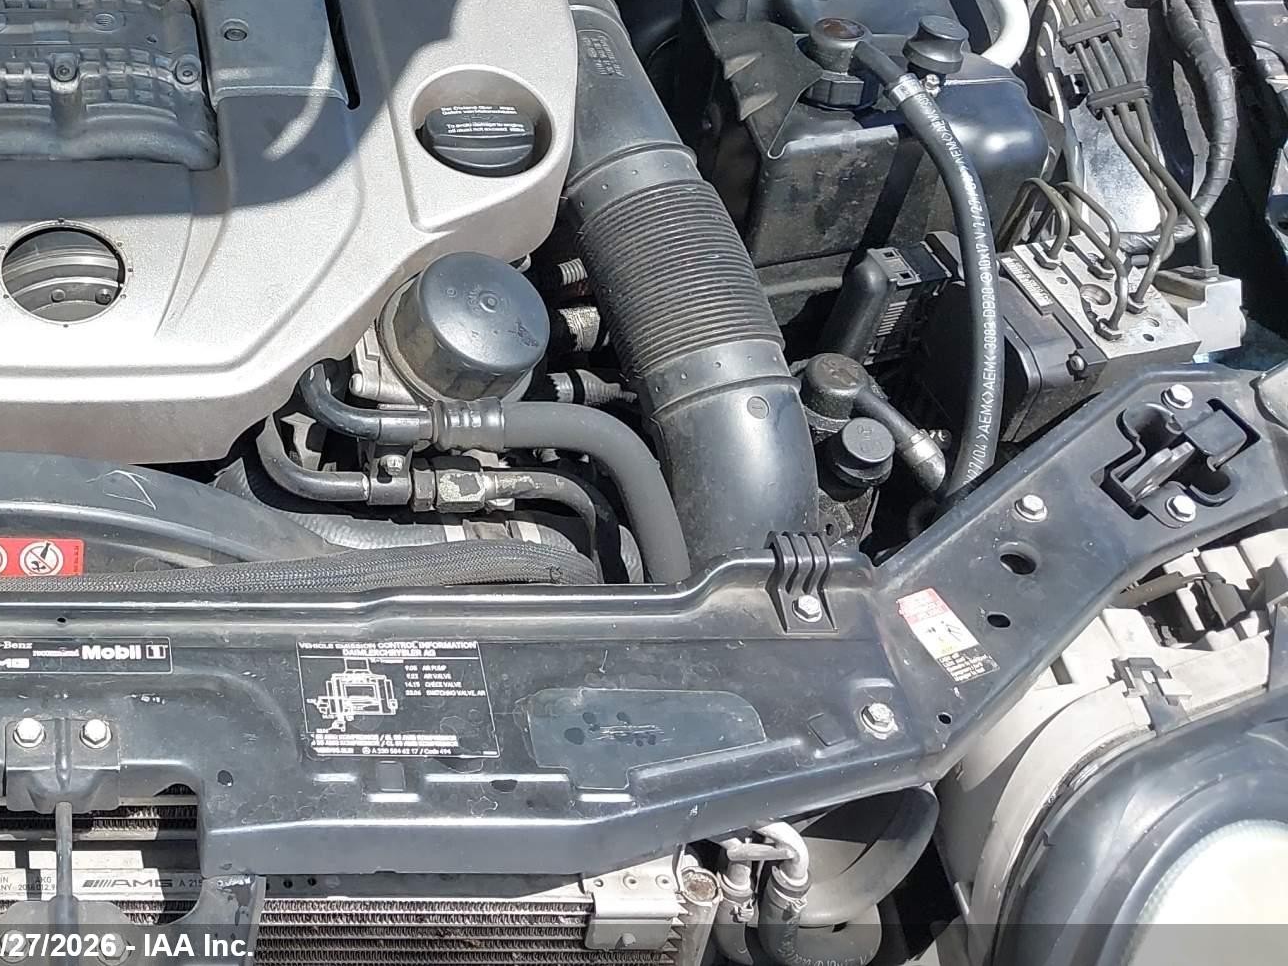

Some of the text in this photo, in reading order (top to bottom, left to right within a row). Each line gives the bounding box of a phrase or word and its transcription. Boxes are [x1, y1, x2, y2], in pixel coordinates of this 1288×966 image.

[299, 641, 334, 650] VEHICLE
[377, 641, 417, 649] CONTROL
[417, 641, 477, 649] INFORMATION
[81, 644, 141, 660] Mobil
